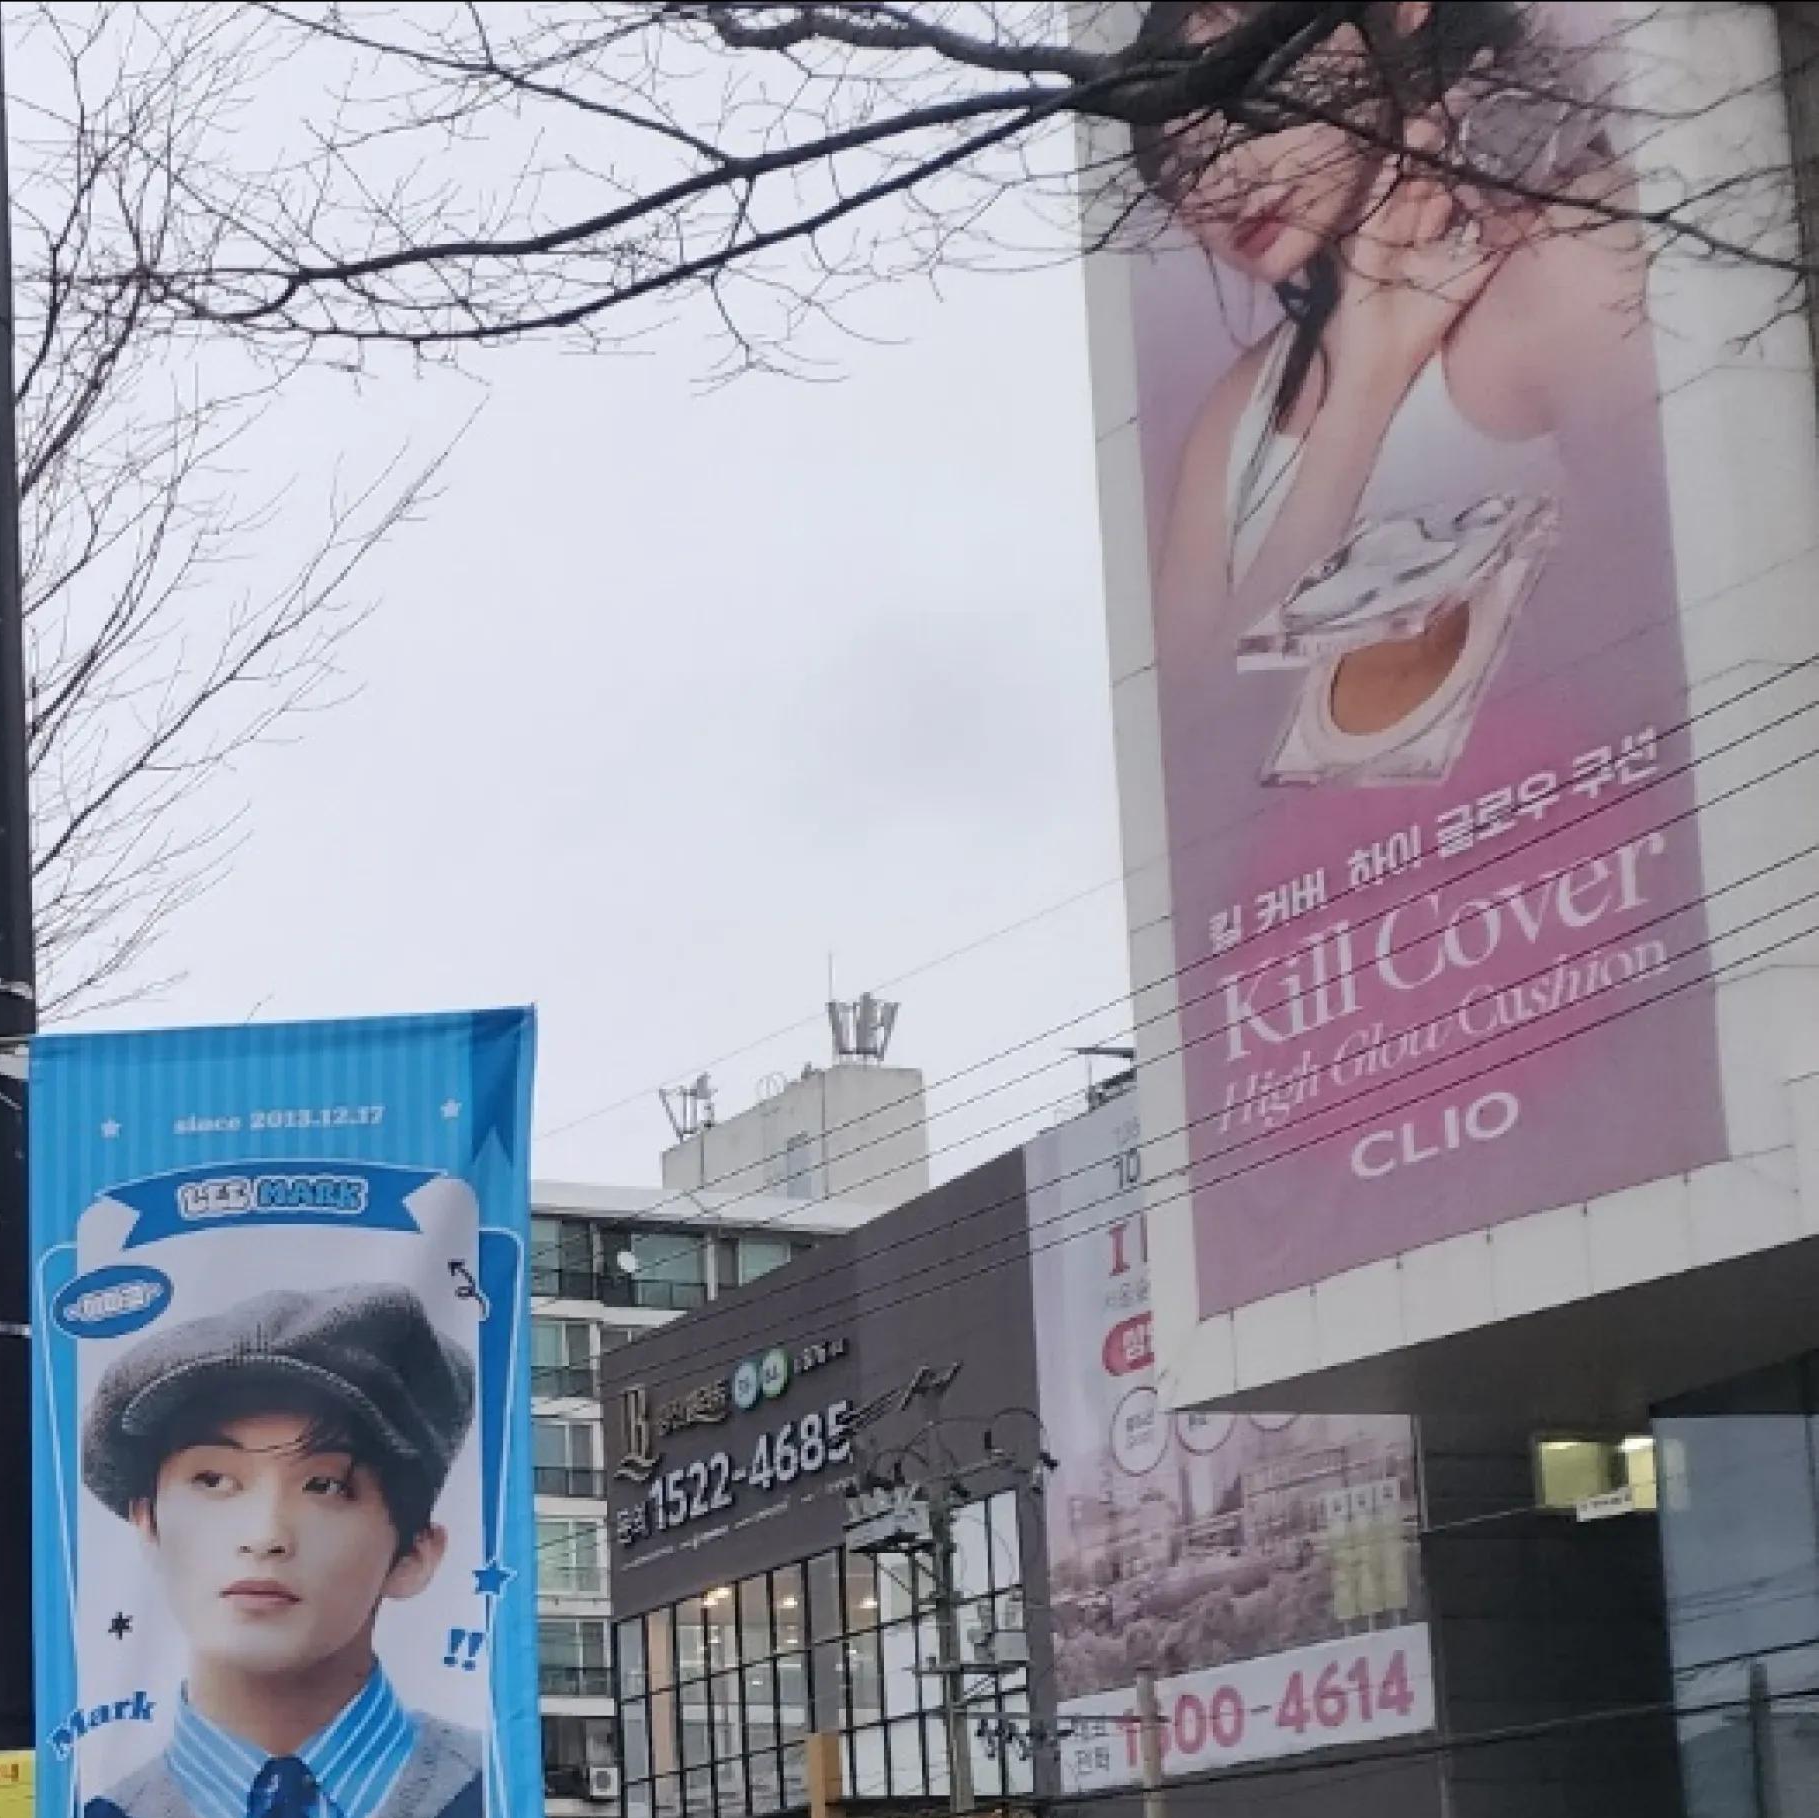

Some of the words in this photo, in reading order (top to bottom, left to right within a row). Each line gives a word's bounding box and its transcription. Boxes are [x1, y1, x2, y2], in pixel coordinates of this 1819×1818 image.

[1208, 905, 1242, 952] 킬
[1255, 868, 1328, 924] 커버
[1347, 825, 1423, 888] 하이
[1436, 772, 1561, 857] 글로우
[1572, 726, 1659, 798] 쿠션
[1216, 920, 1363, 1063] Kill
[1376, 832, 1667, 990] Cover
[1218, 1050, 1320, 1134] High
[1332, 1021, 1458, 1087] Glow
[1457, 939, 1671, 1036] Cushion
[174, 1112, 242, 1135] since
[249, 1103, 387, 1130] 2013.12.17
[1351, 1091, 1520, 1178] CLIO
[257, 1176, 366, 1211] MARK
[649, 1400, 854, 1531] 1522-4685
[46, 1690, 157, 1761] Mark
[1116, 1650, 1415, 1768] 100-4614
